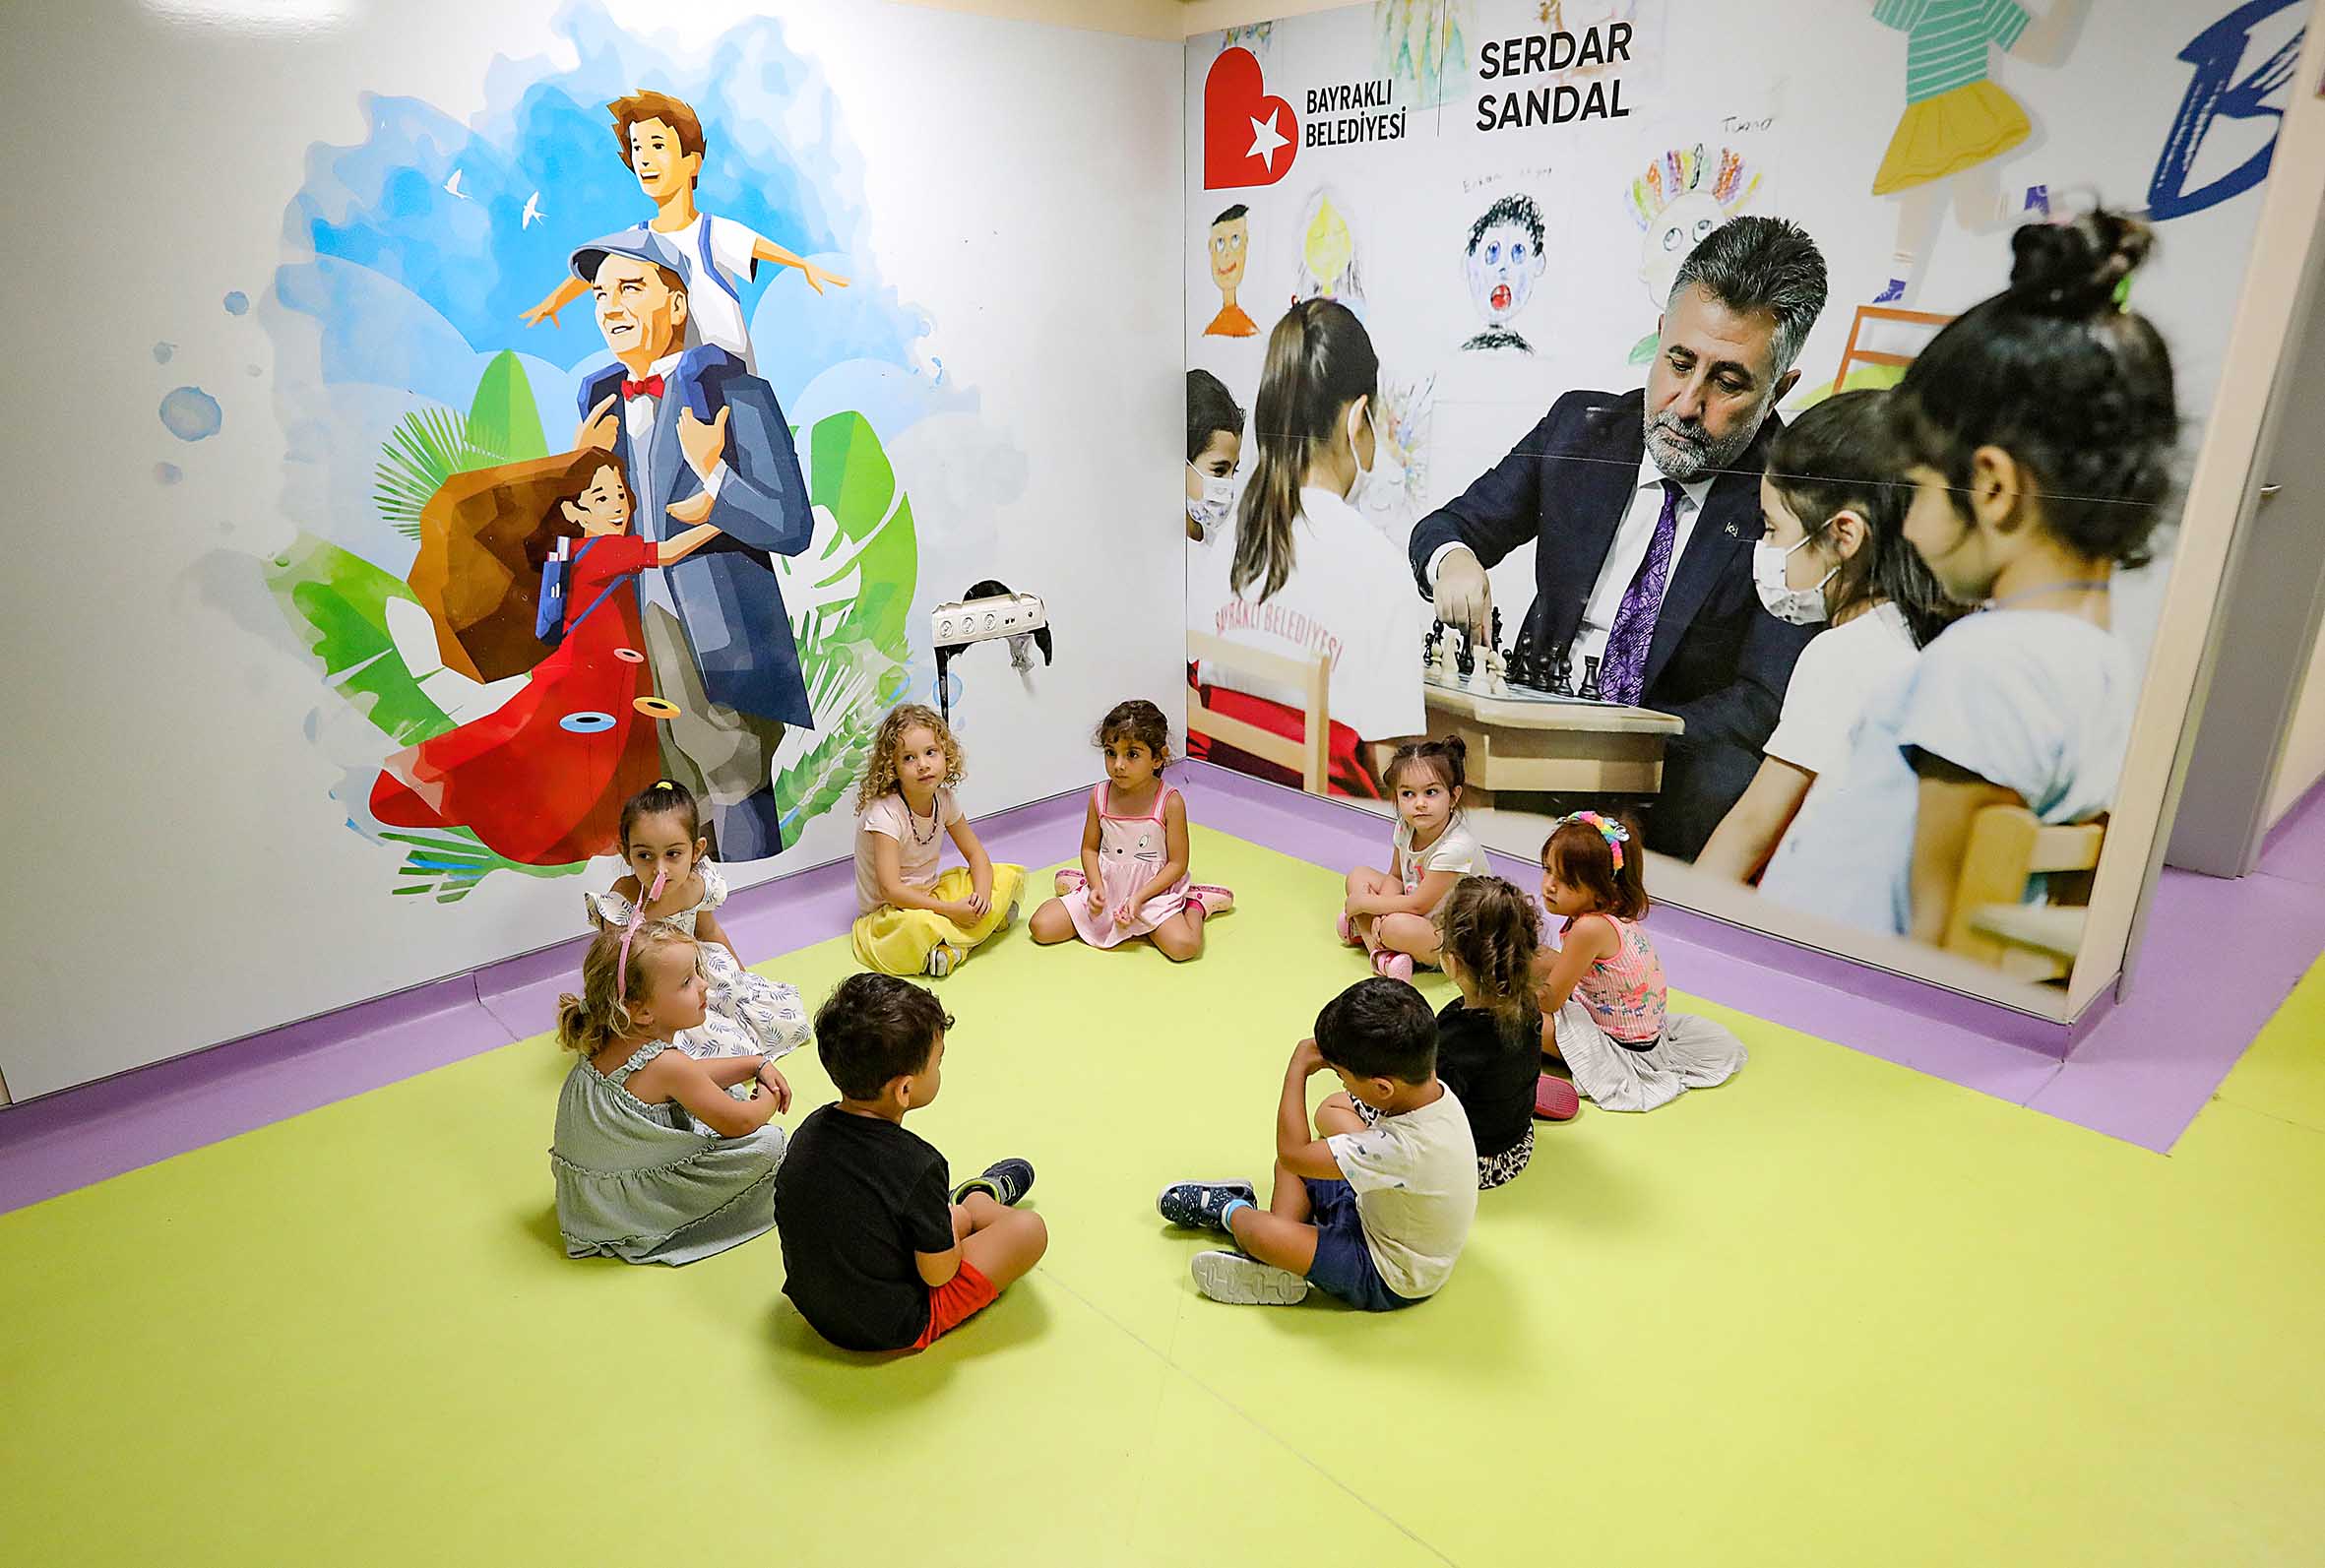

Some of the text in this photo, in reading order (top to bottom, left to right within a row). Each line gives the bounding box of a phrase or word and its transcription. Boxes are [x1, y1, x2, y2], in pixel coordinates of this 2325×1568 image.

[1478, 22, 1633, 80] SERDAR
[1306, 79, 1393, 115] BAYRAKLI
[1476, 79, 1630, 132] SANDAL
[1305, 105, 1408, 149] BELEDİYESİ
